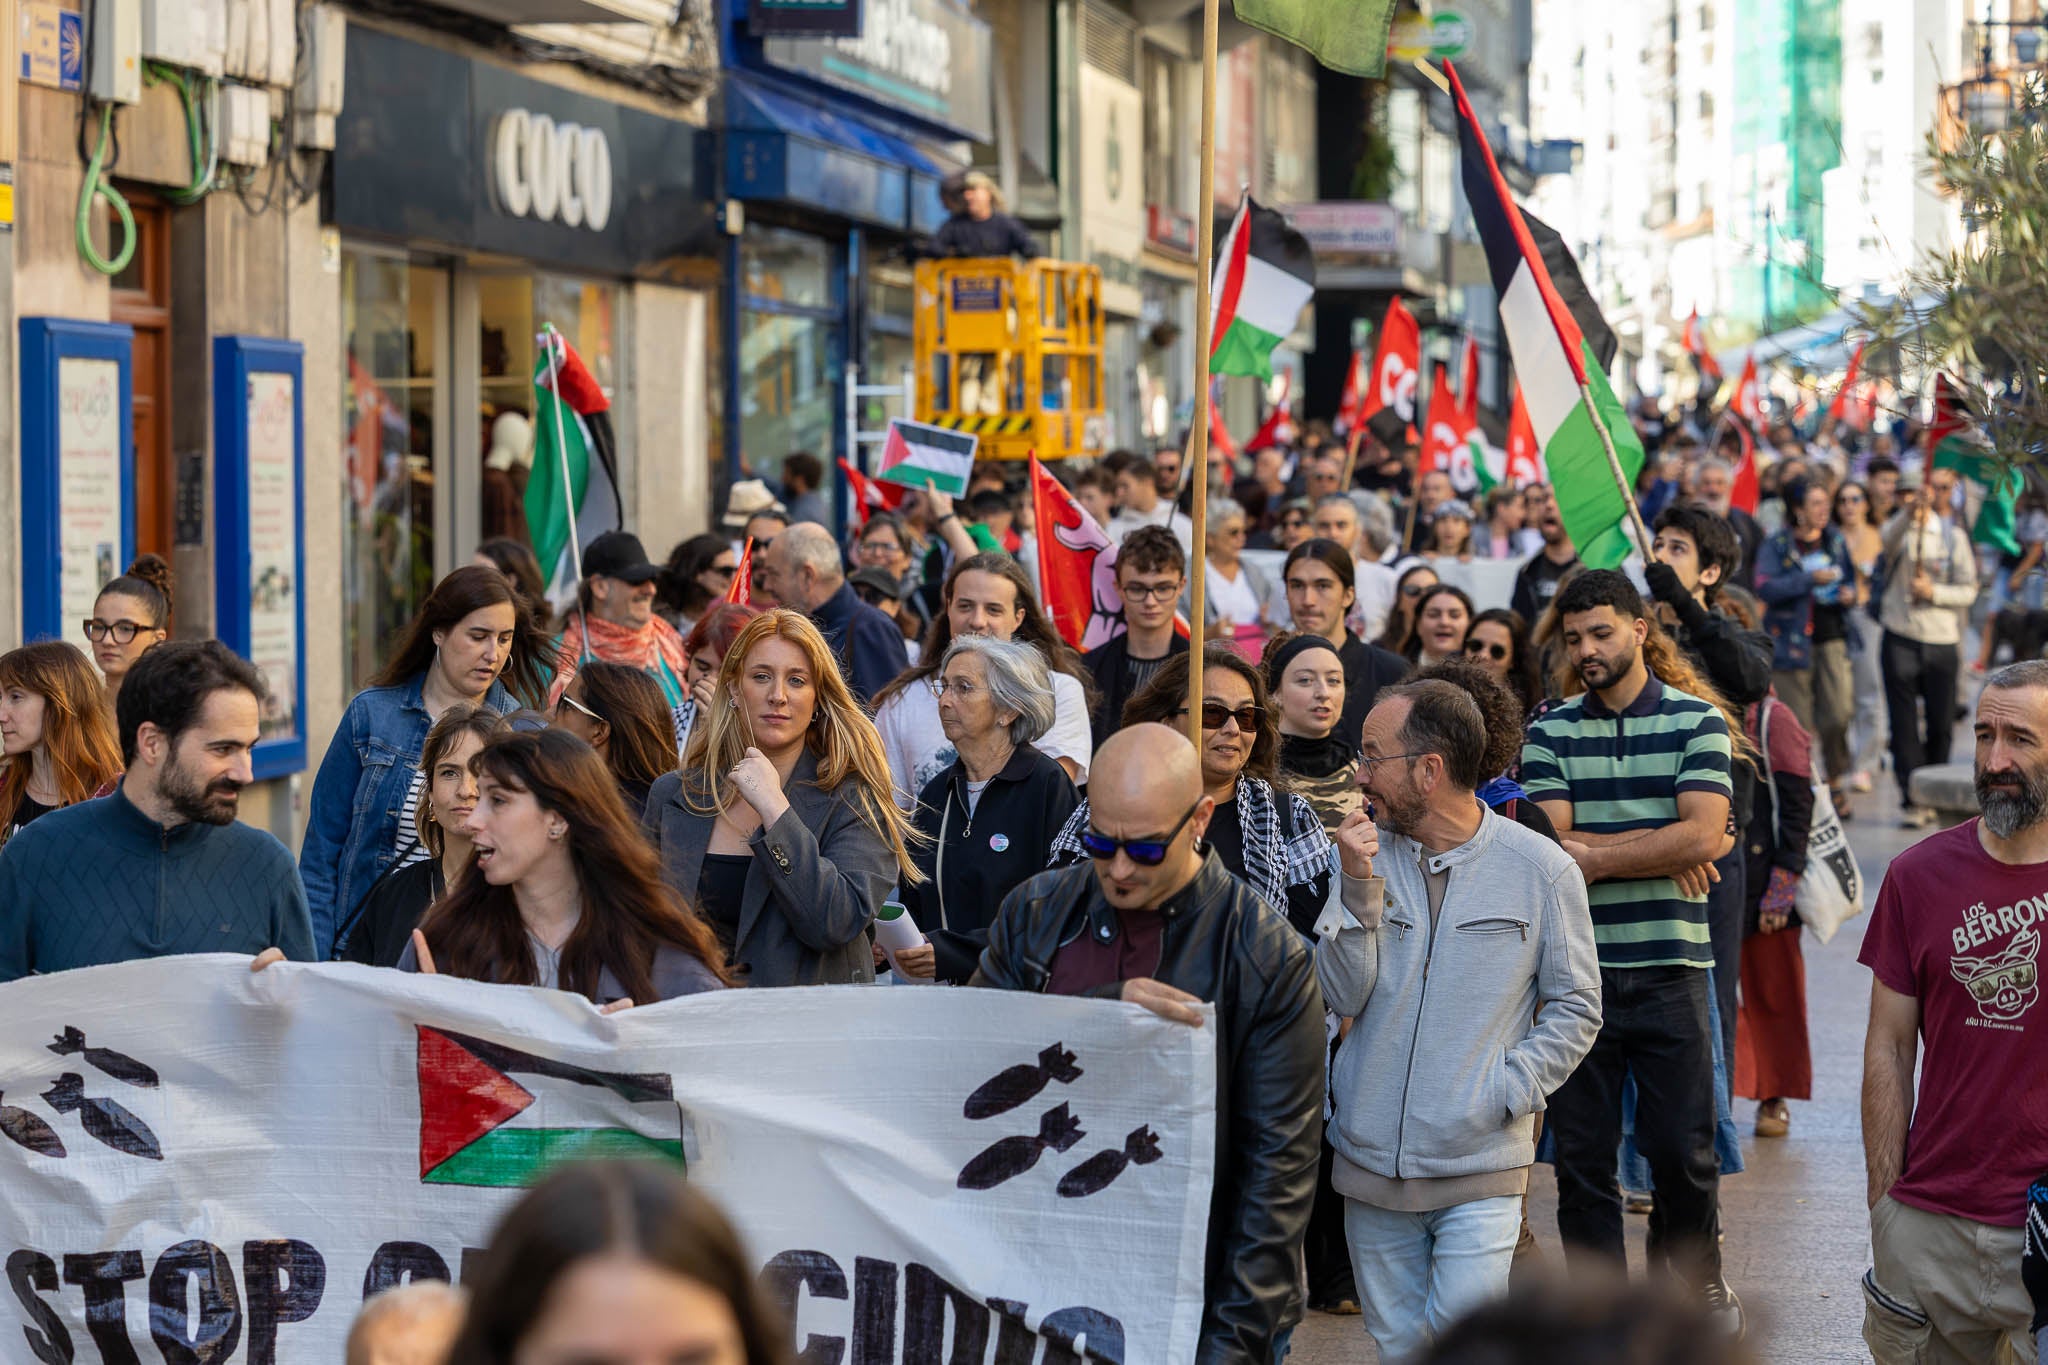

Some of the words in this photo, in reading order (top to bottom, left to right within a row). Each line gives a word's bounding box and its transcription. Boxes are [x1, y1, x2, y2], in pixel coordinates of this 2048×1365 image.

[496, 107, 612, 233] COCO
[1962, 901, 1987, 922] LOS
[5, 1239, 326, 1365] STOP
